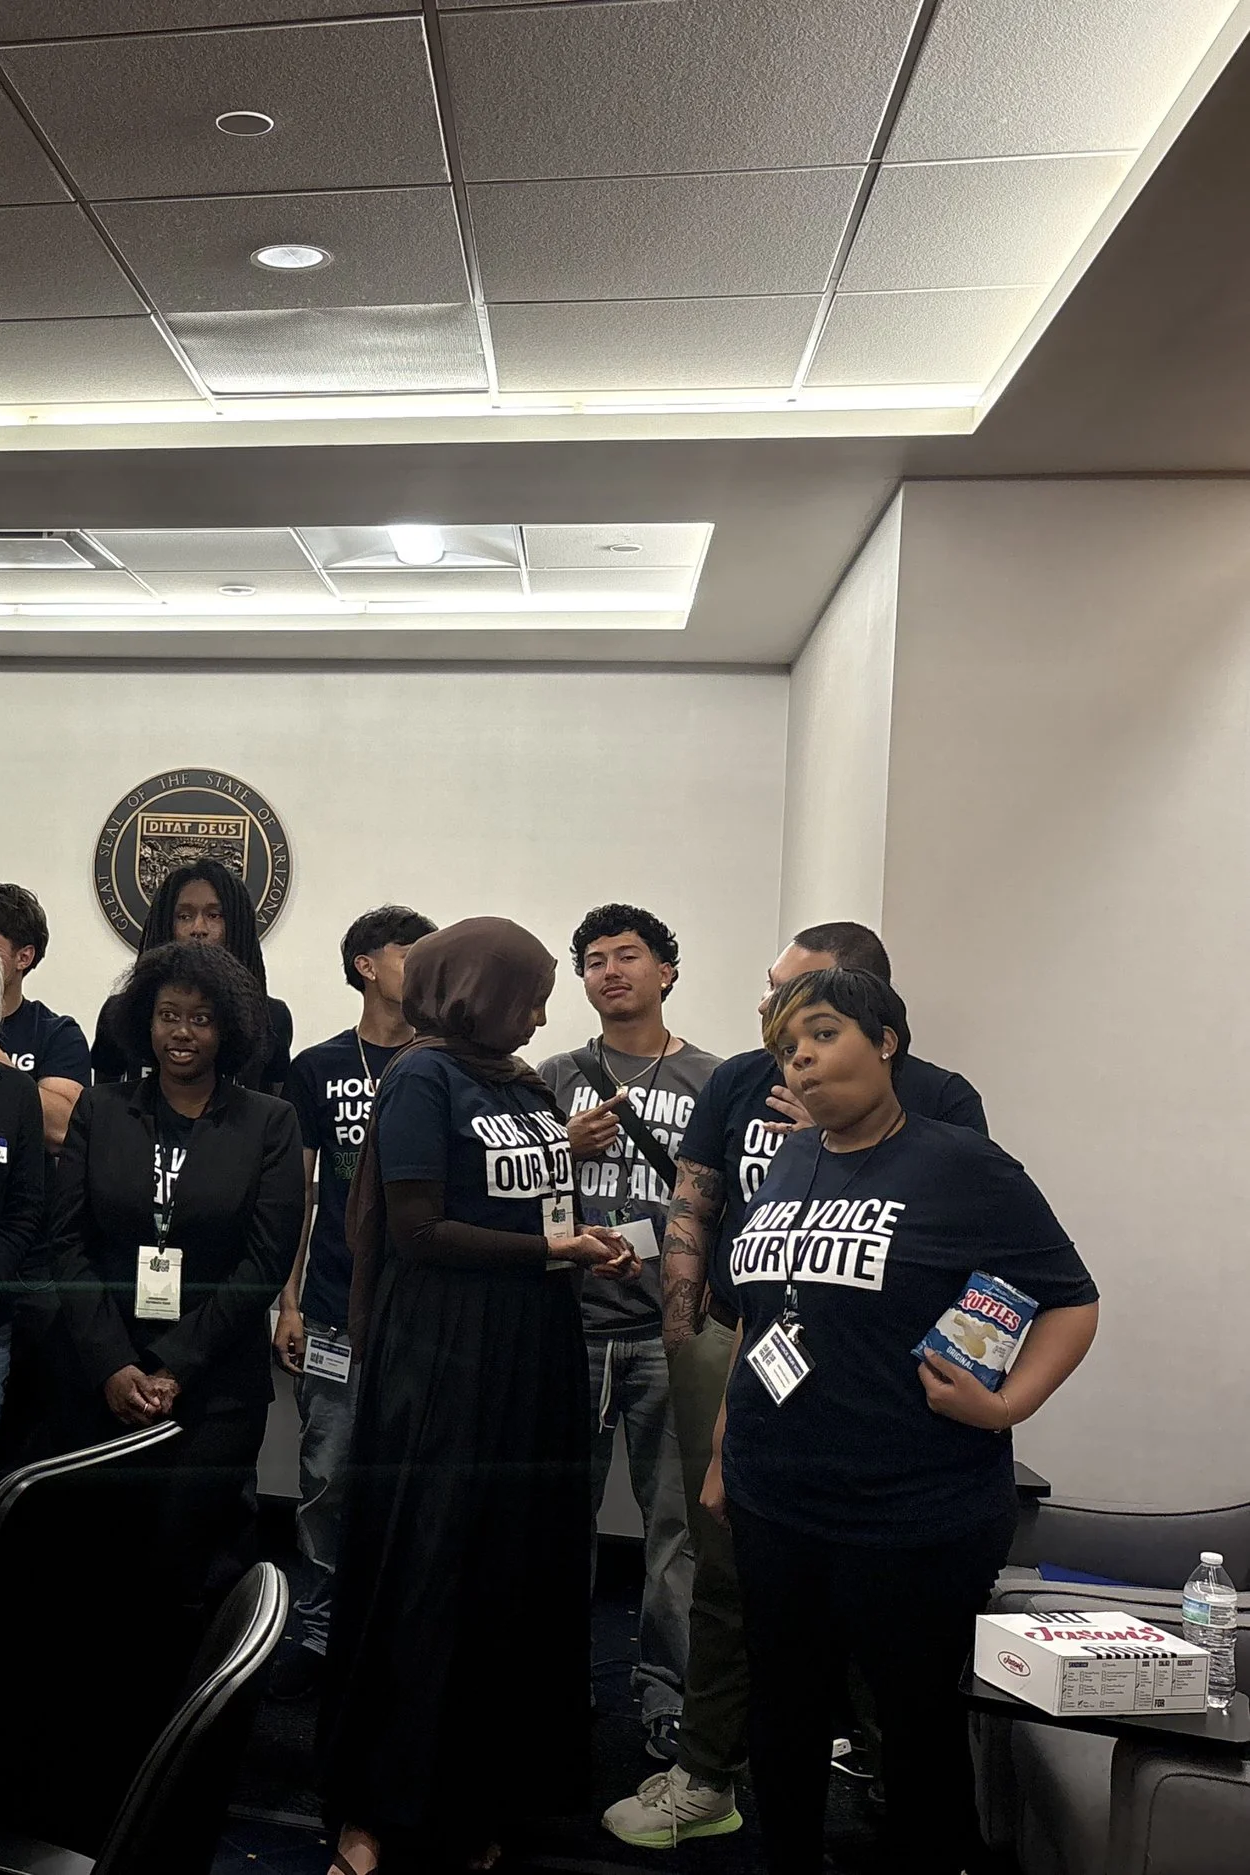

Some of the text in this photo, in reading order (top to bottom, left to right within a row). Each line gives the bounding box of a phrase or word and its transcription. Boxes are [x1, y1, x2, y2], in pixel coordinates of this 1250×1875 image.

[149, 821, 237, 835] DITAT DEUS
[99, 772, 288, 931] GREAT SEAL OF THE STATE OF ARIZONA
[470, 1113, 531, 1148] OUR
[494, 1153, 545, 1192] OUR
[741, 1198, 906, 1236] OUR VOICE
[732, 1235, 882, 1282] OUR VOTE
[960, 1288, 1022, 1332] RUFFLES
[945, 1345, 976, 1372] ORIGINAL
[1024, 1626, 1166, 1642] Jason's
